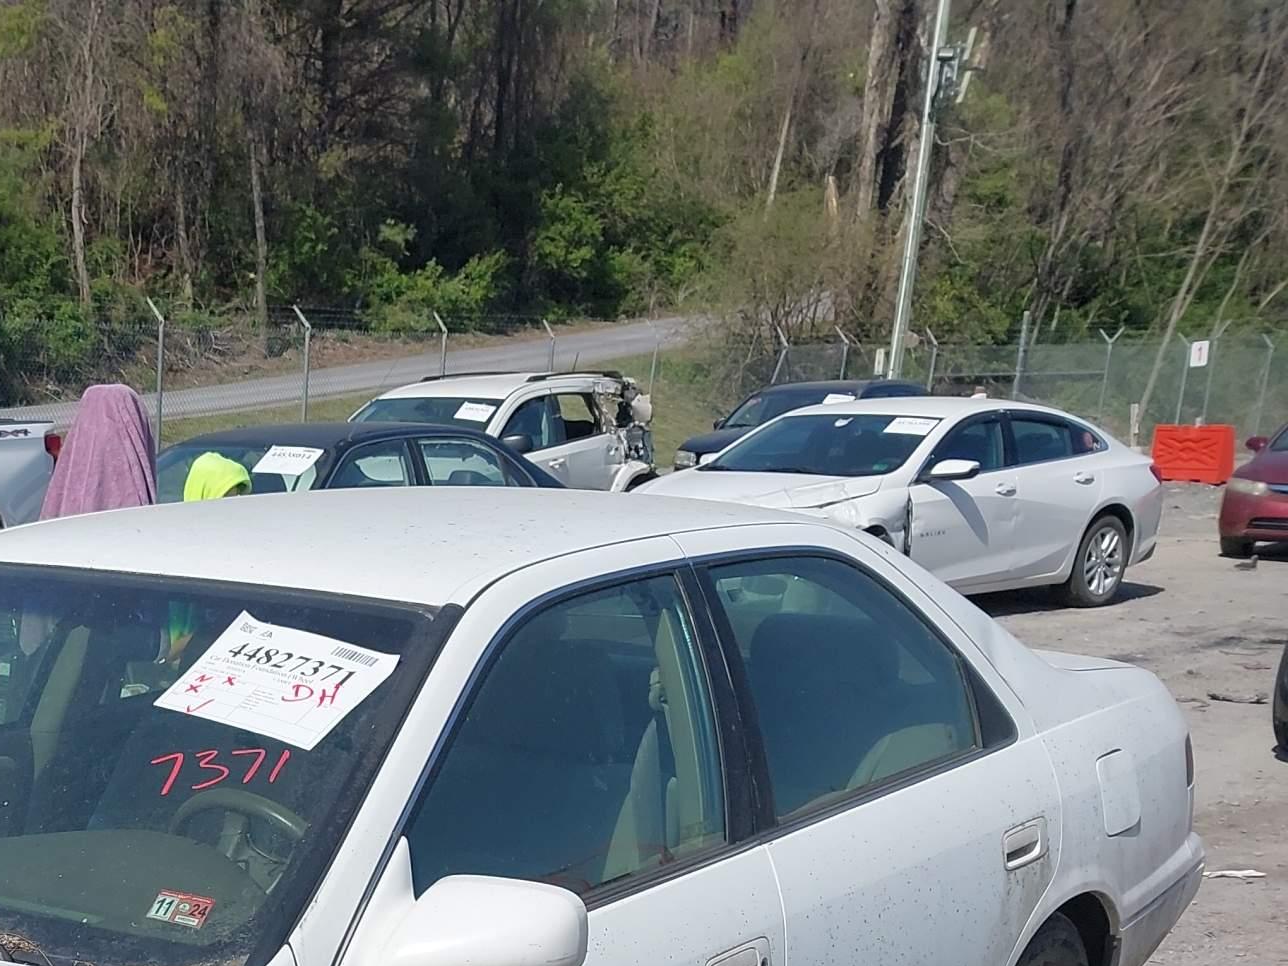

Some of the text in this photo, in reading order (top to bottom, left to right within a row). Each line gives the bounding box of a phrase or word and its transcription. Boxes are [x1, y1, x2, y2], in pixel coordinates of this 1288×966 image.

[228, 642, 356, 686] 44827371
[150, 748, 290, 796] 7371
[155, 898, 209, 918] 11 24
